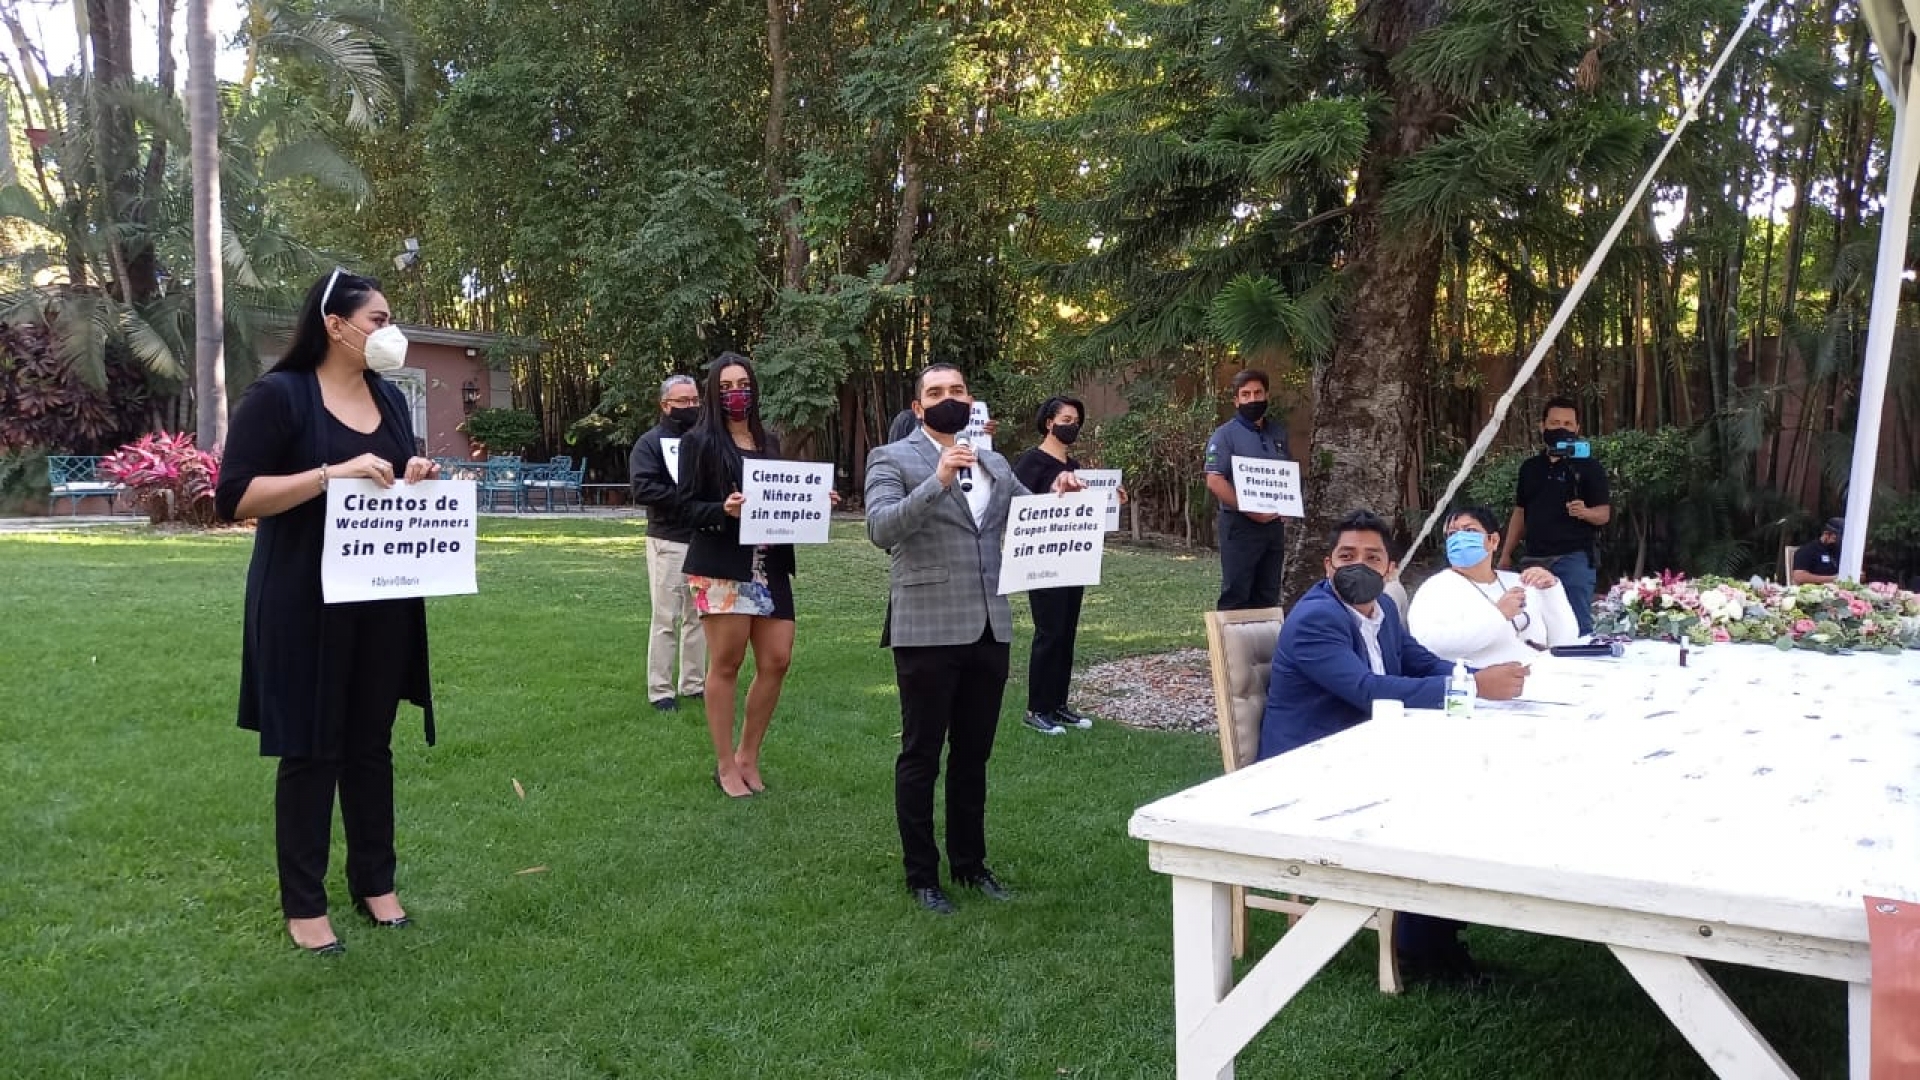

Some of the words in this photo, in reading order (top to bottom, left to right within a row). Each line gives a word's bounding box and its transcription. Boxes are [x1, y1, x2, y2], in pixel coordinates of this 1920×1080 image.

[752, 470, 800, 484] Cientos
[805, 473, 822, 485] de
[1238, 463, 1275, 475] Cientos
[1278, 467, 1290, 477] de
[1246, 476, 1288, 489] Floristas
[763, 488, 813, 502] Niñeras
[1242, 488, 1258, 497] sin
[1259, 491, 1296, 502] empleo
[344, 495, 428, 511] Cientos
[434, 495, 459, 511] de
[750, 507, 769, 520] sin
[773, 509, 821, 522] empleo
[1019, 507, 1071, 521] Cientos
[1075, 504, 1093, 516] de
[336, 517, 403, 531] Wedding
[408, 517, 469, 529] Planners
[1013, 526, 1047, 537] Grupos
[1049, 522, 1099, 533] Musicales
[341, 540, 375, 556] sin
[383, 538, 461, 558] empleo
[1013, 543, 1034, 558] sin
[1038, 540, 1093, 556] empleo
